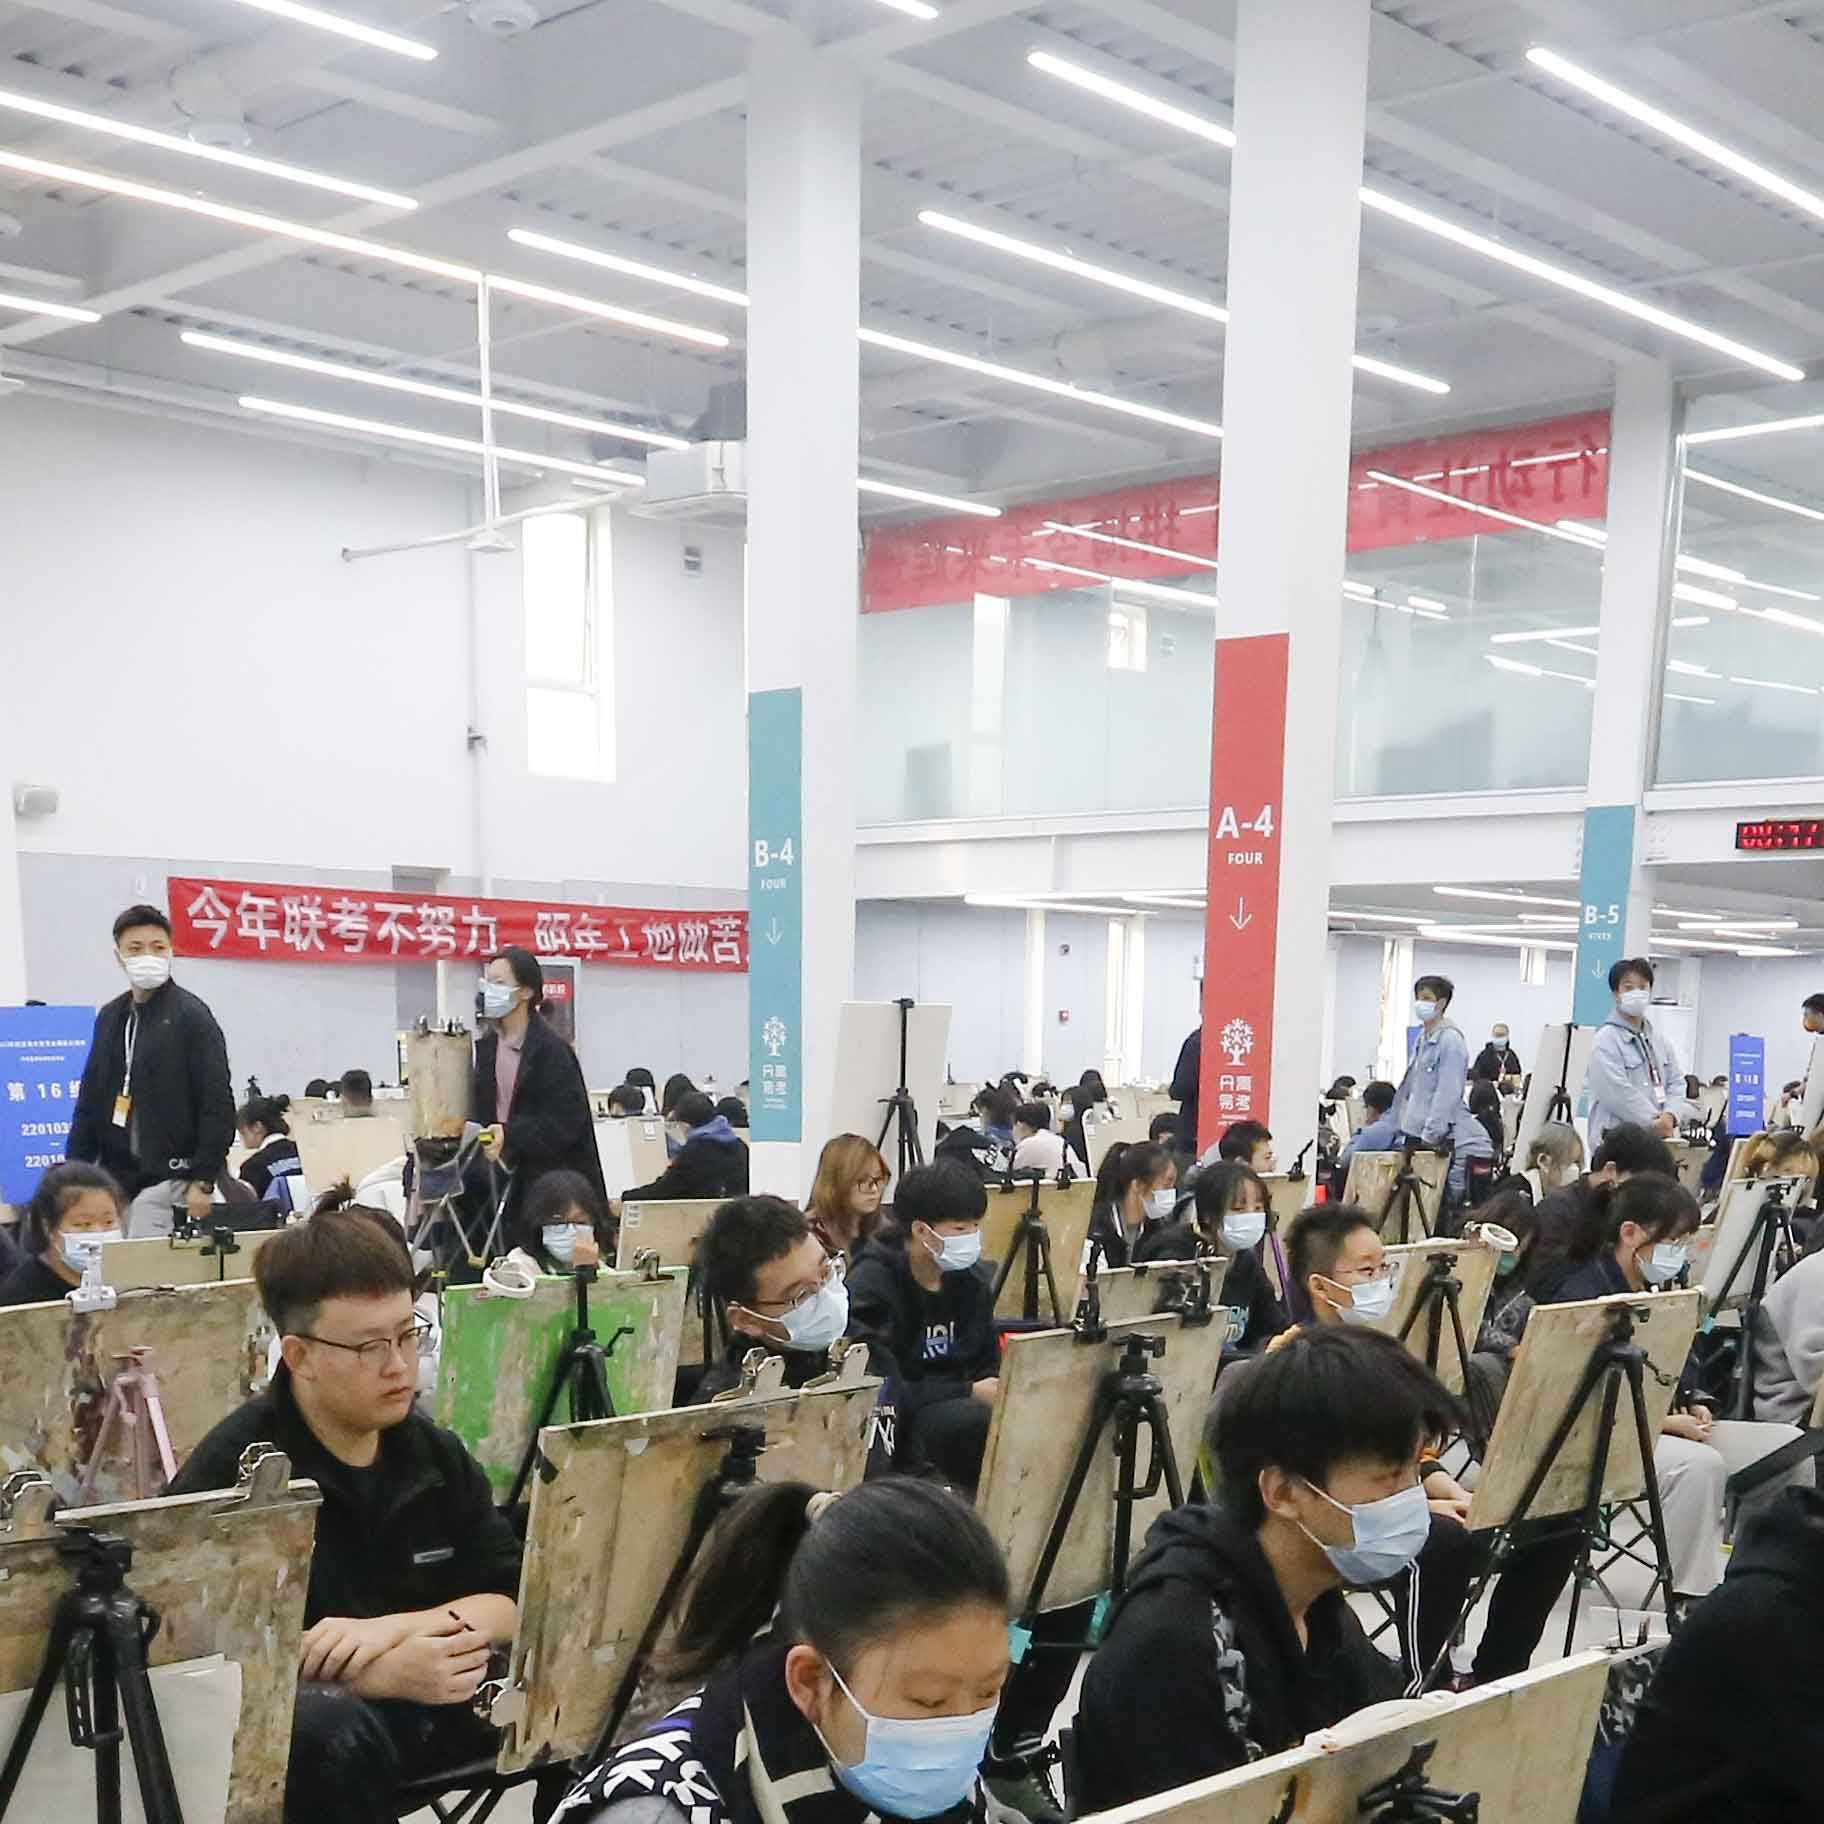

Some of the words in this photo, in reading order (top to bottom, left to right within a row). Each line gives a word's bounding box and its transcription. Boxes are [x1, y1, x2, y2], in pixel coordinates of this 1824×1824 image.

[1216, 805, 1274, 840] A-4
[754, 838, 794, 868] B-4
[1227, 852, 1263, 865] FOUR
[1584, 904, 1619, 924] B-5
[534, 911, 750, 966] 明年工地做苦
[37, 1083, 62, 1098] 16
[22, 1122, 72, 1136] 220103
